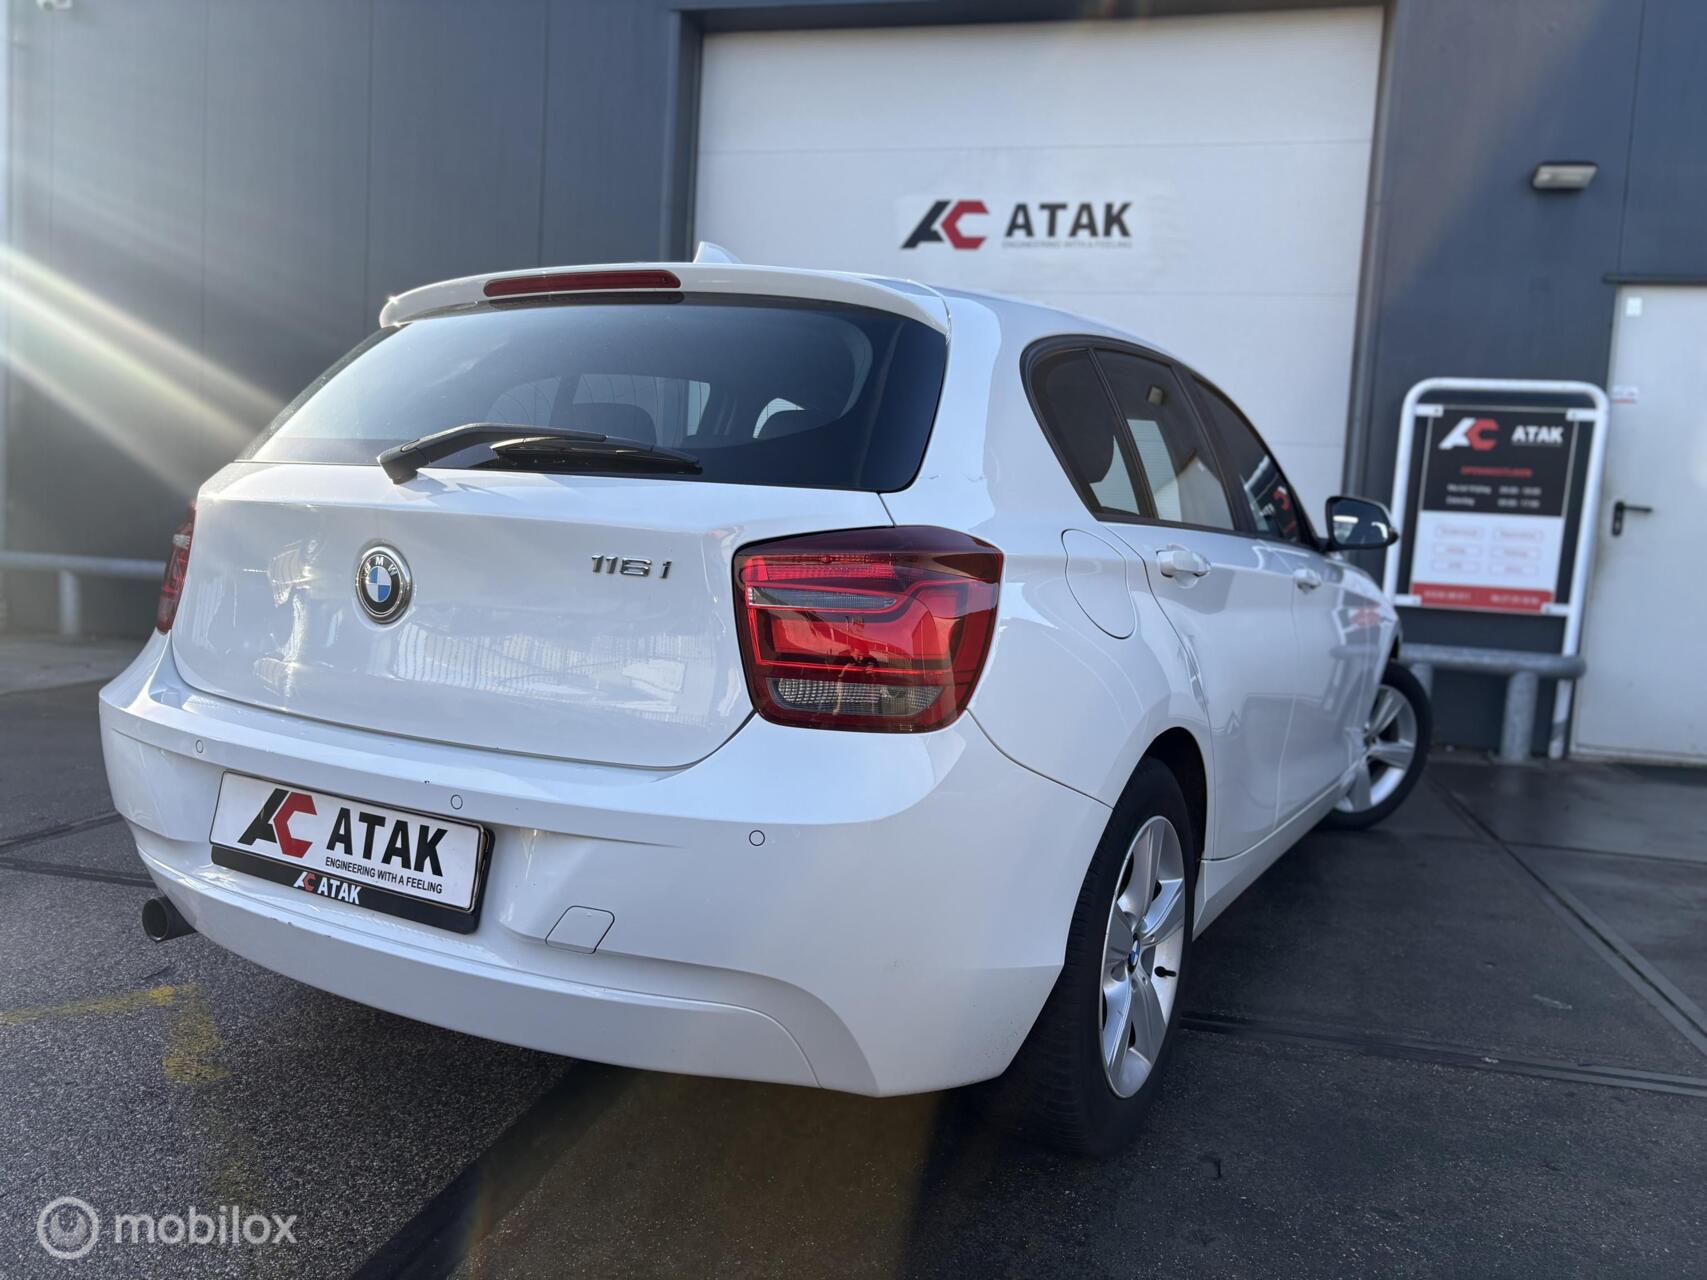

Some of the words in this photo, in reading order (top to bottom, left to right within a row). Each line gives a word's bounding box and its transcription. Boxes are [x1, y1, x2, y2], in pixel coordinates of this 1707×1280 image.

[1005, 202, 1132, 238] ATAK
[1511, 425, 1564, 442] ATAK
[363, 556, 398, 577] BMW
[326, 807, 448, 877] ATAK
[317, 876, 363, 904] ATAK
[325, 856, 376, 878] ENGINEERING
[377, 870, 398, 884] WITH
[400, 876, 405, 886] A
[406, 876, 443, 894] FEELING
